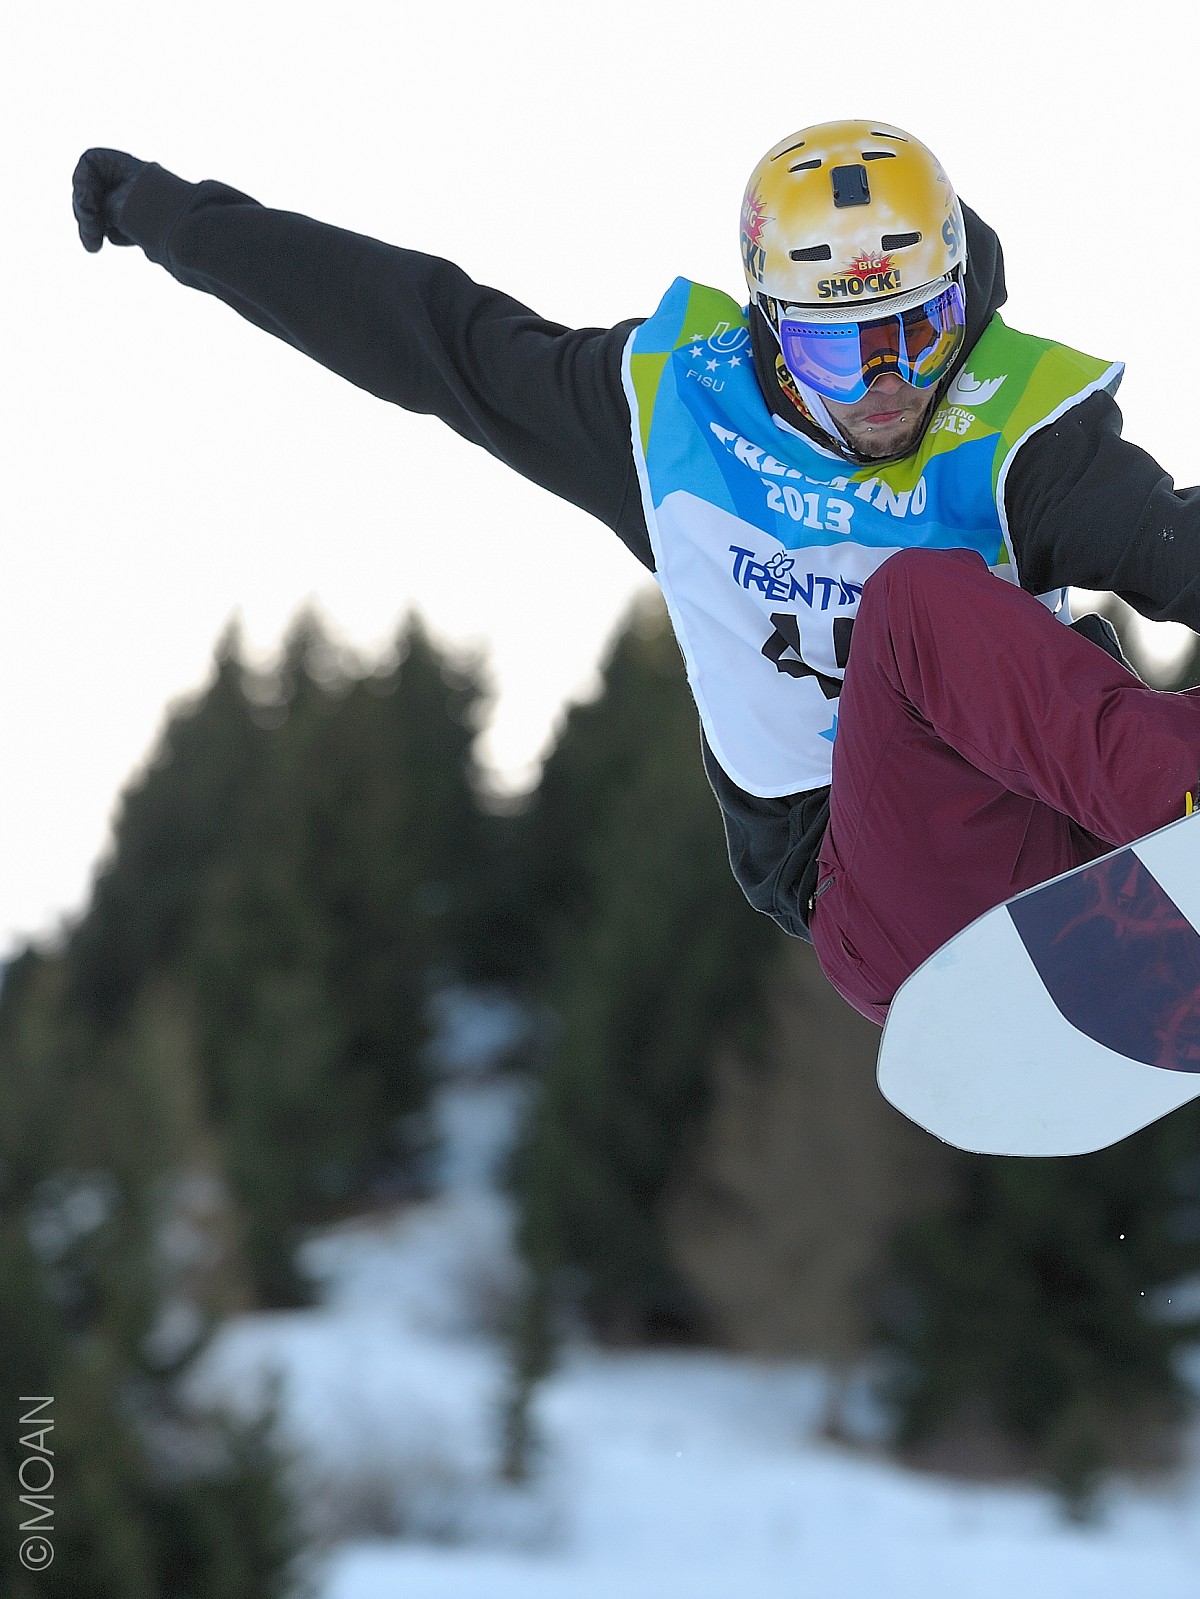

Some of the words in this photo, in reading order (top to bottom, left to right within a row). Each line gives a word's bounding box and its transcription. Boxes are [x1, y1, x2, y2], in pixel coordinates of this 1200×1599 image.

[858, 259, 882, 271] BIG
[817, 269, 902, 299] SHOCK!
[685, 368, 726, 393] FISU
[929, 415, 971, 435] 213
[760, 476, 855, 534] 2013
